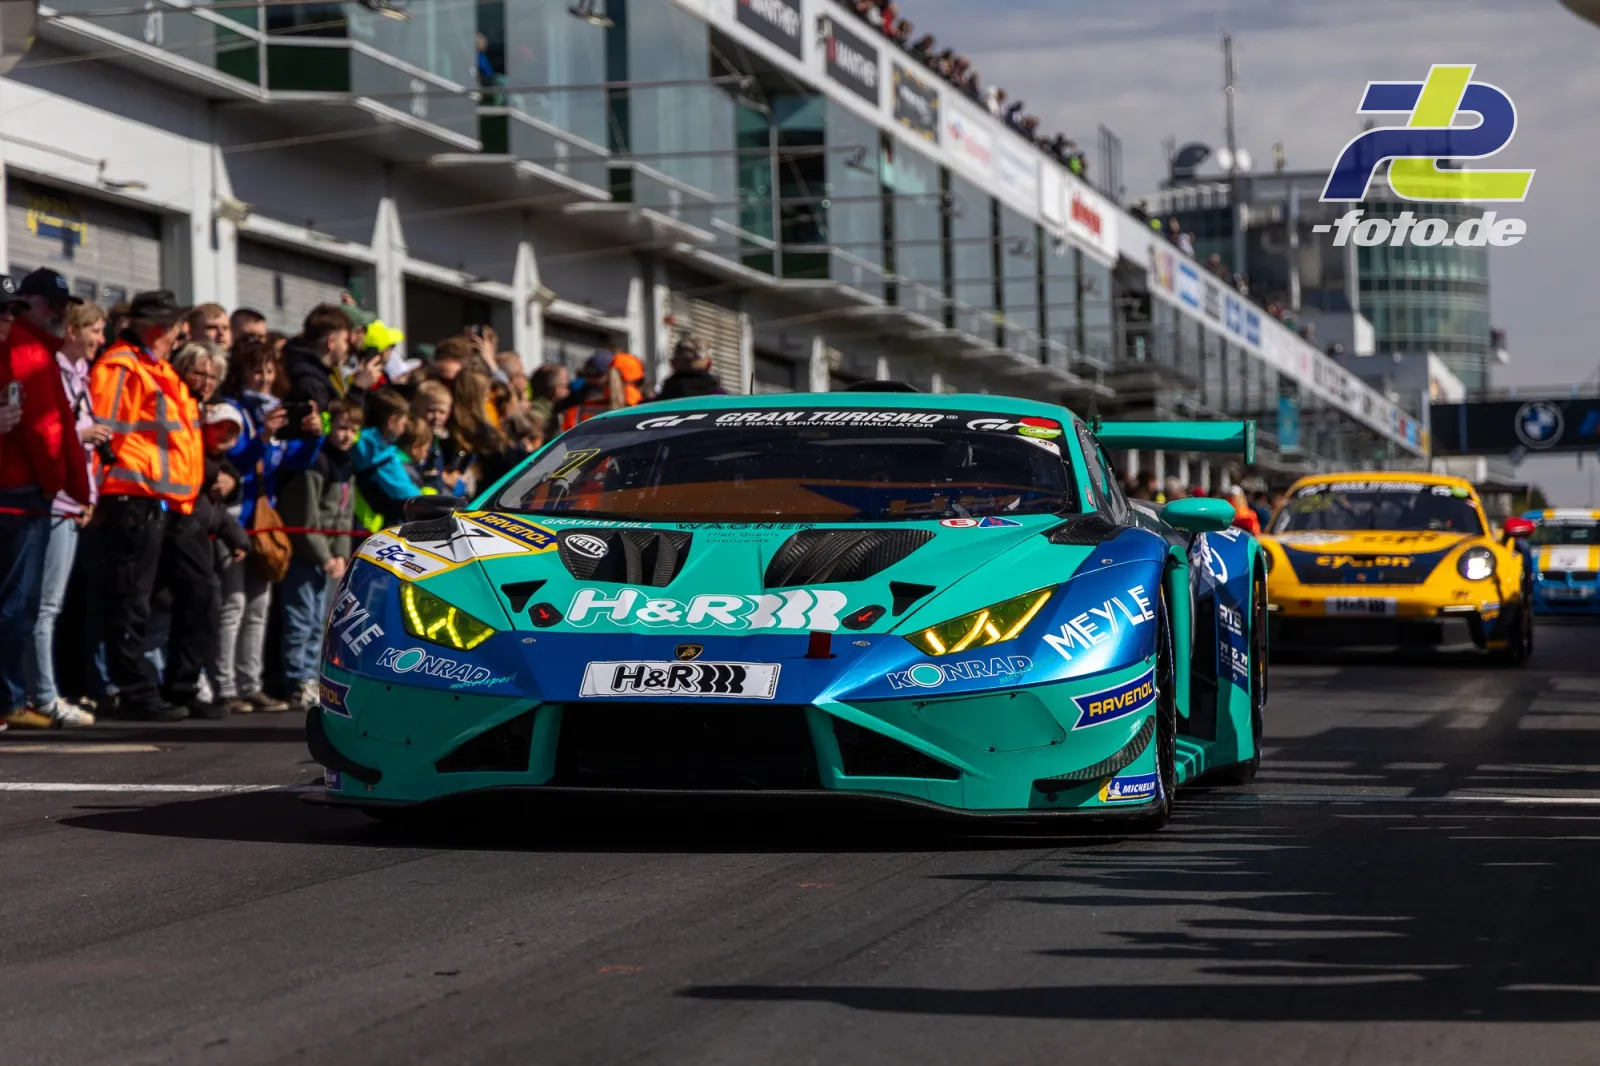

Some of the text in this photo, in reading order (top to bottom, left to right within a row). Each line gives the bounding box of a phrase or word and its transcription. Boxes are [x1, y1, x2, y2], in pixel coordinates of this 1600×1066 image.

[715, 411, 805, 423] GRAN
[552, 448, 601, 478] 7
[480, 513, 550, 545] RAVENOL
[541, 518, 653, 529] GRAHAM HILL
[676, 523, 816, 531] WAGNER
[565, 588, 757, 630] H&R
[1042, 584, 1155, 661] MEYLE
[376, 647, 491, 682] KONRAD
[611, 664, 701, 693] H&R
[886, 655, 1034, 690] KONRAD
[1089, 680, 1153, 718] RAVENOL
